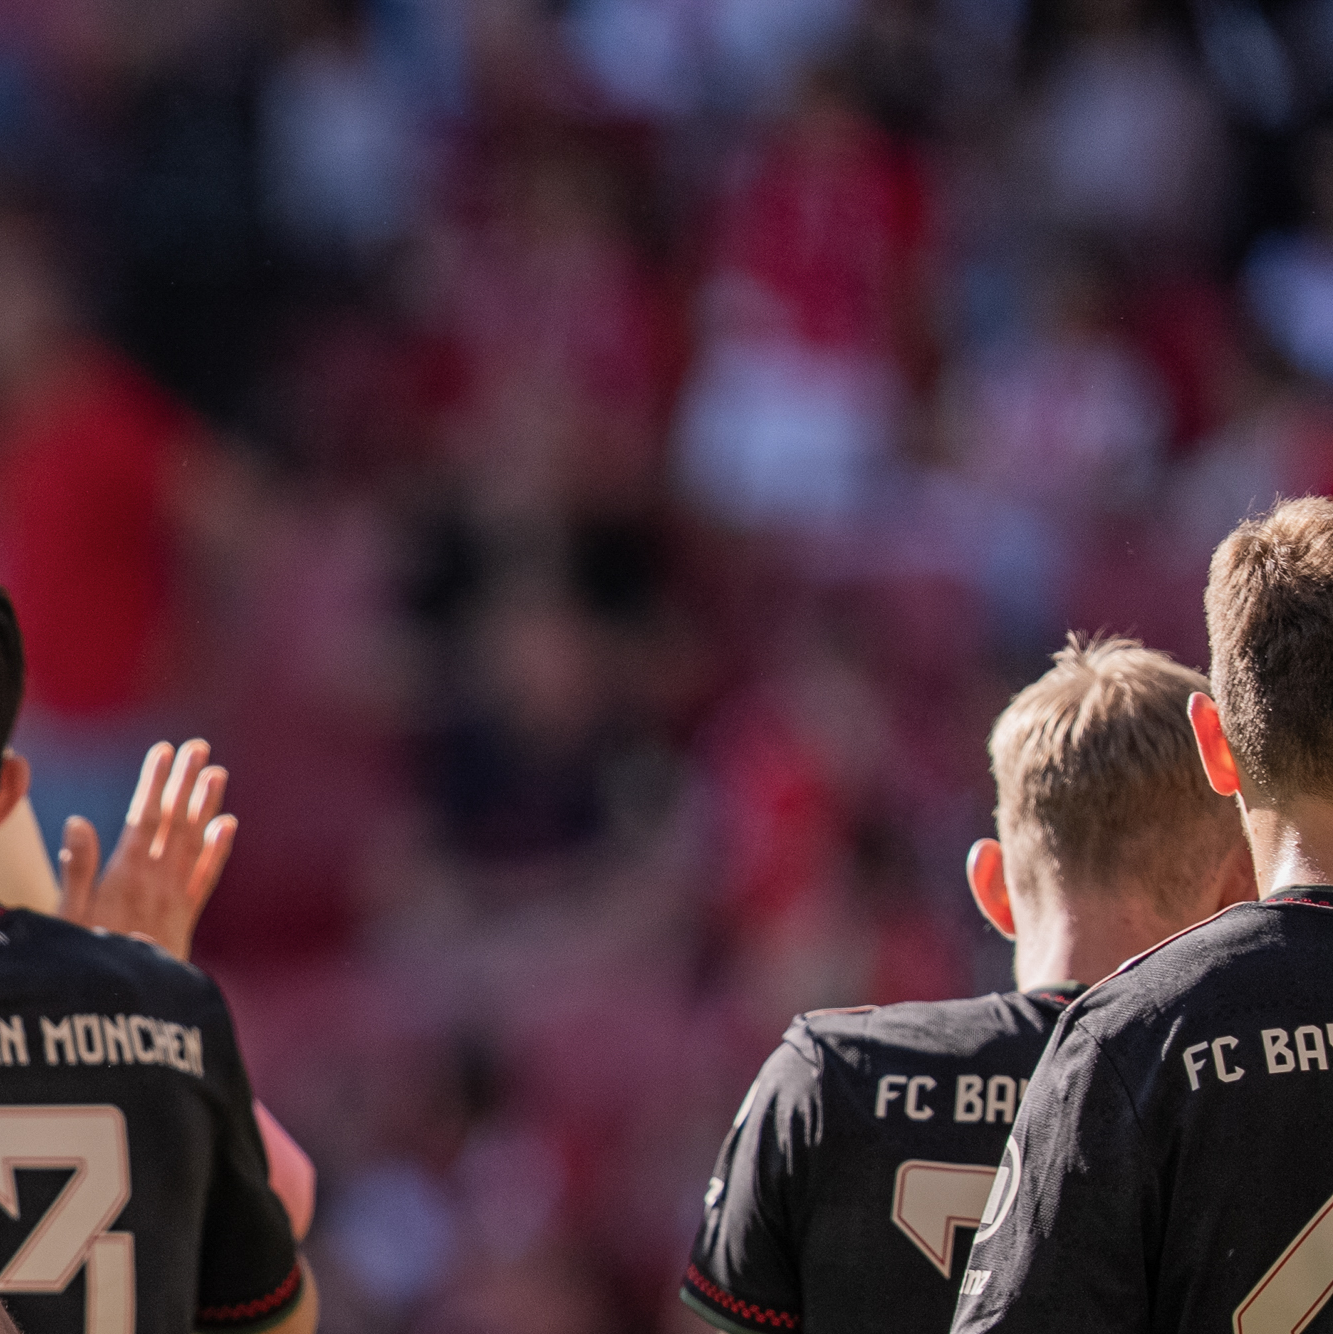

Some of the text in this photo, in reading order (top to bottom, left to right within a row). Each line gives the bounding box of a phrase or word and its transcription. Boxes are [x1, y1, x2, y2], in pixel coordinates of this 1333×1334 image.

[1182, 1035, 1245, 1092] FC
[874, 1073, 1031, 1125] FC BA
